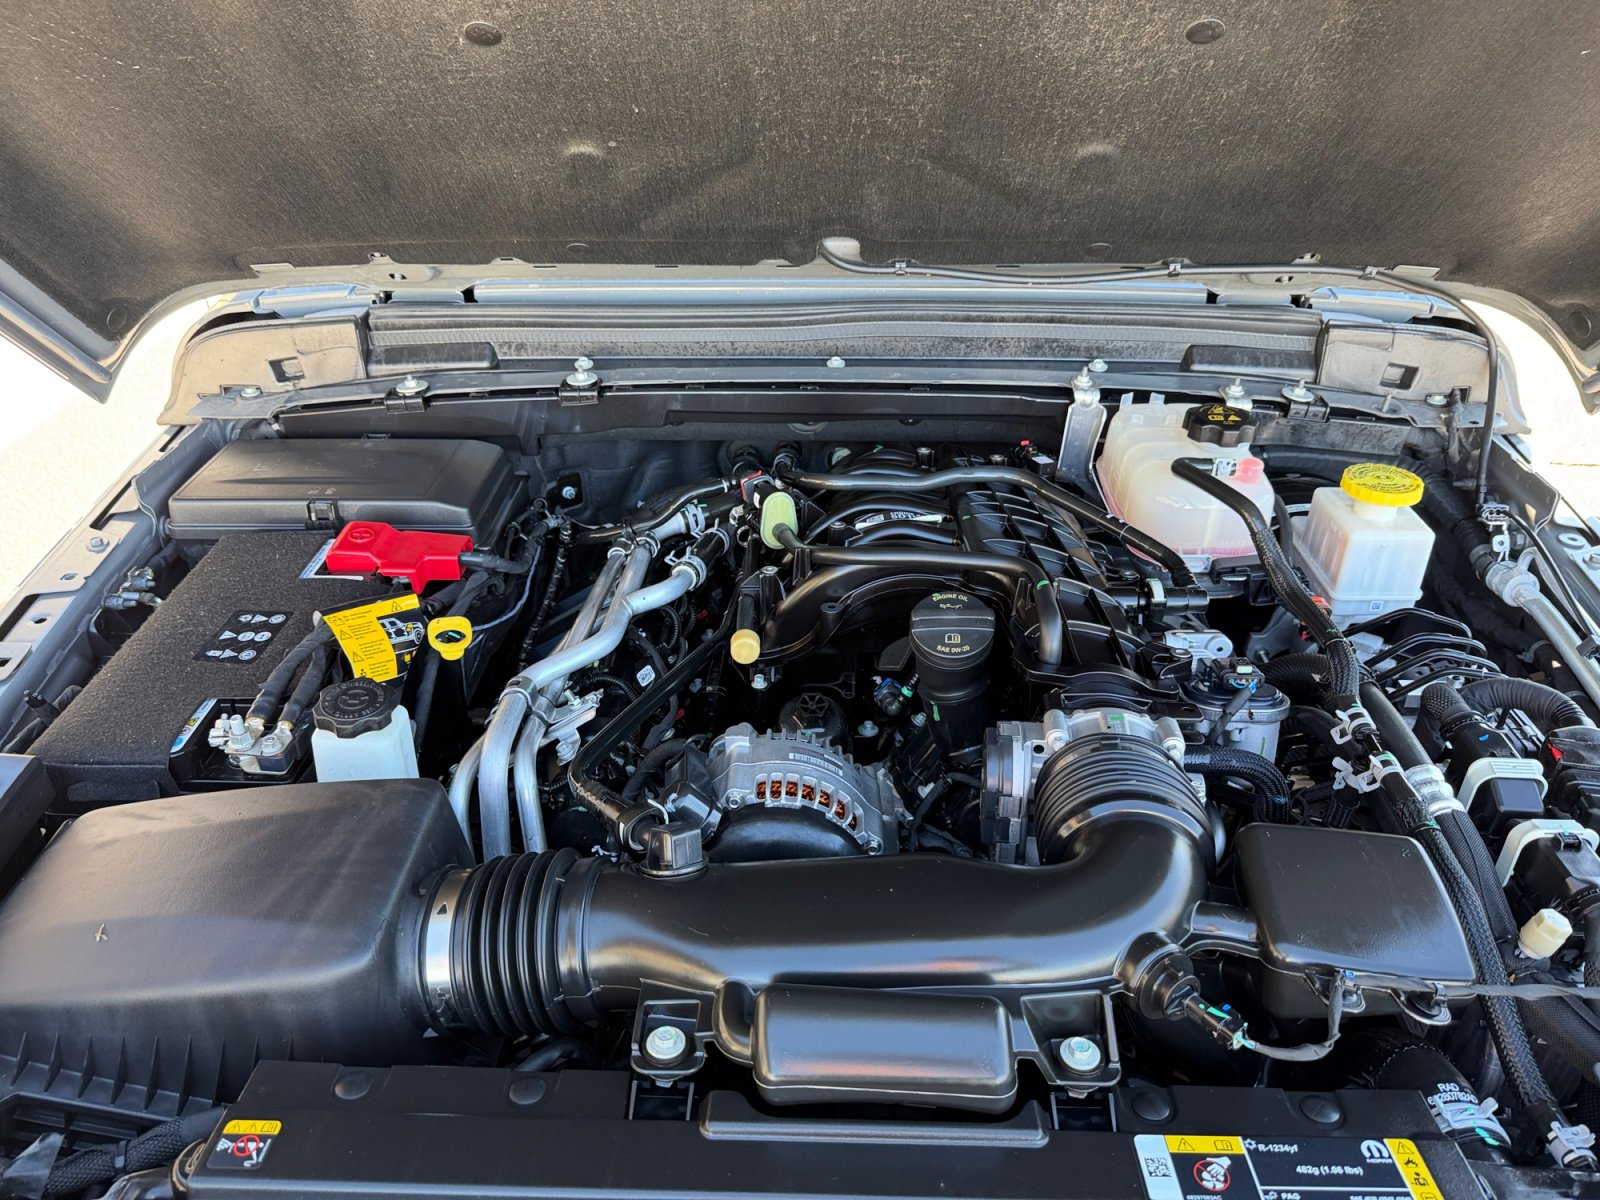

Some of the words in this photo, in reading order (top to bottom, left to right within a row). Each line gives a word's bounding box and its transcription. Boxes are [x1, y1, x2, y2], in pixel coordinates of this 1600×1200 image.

[932, 593, 957, 602] ENGINE
[958, 594, 969, 602] OIL
[936, 644, 950, 653] SAE
[951, 644, 970, 653] 0W-20
[1437, 1082, 1460, 1092] RAD
[1257, 1144, 1299, 1154] R-1234yf
